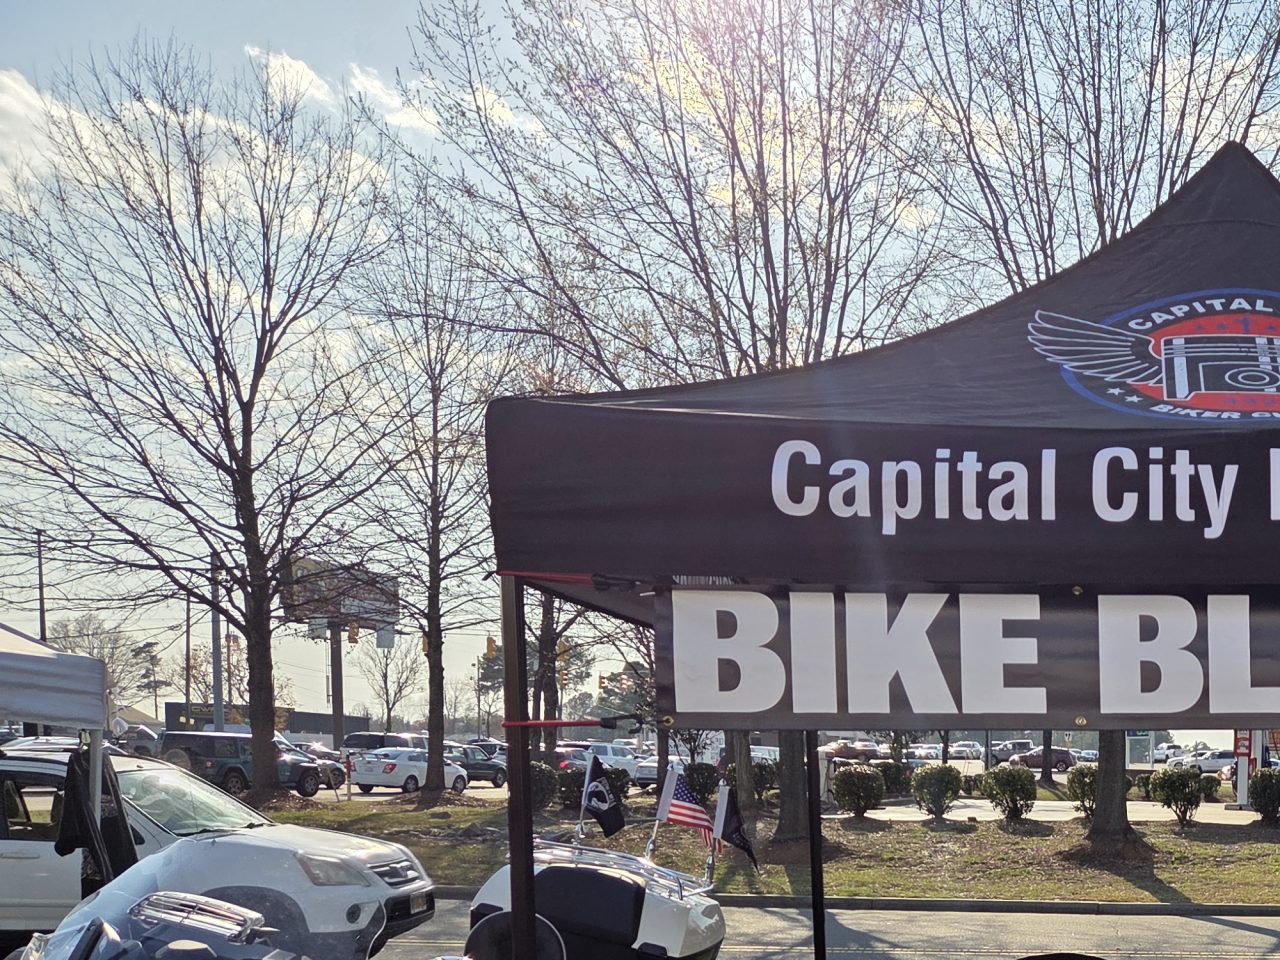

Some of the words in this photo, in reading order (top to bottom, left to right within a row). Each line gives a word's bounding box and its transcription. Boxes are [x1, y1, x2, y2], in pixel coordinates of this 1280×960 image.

[1128, 298, 1273, 330] CAPITAL
[1150, 404, 1241, 419] BIKER
[771, 440, 1056, 535] Capital
[1092, 447, 1240, 539] City
[672, 590, 1047, 714] BIKE
